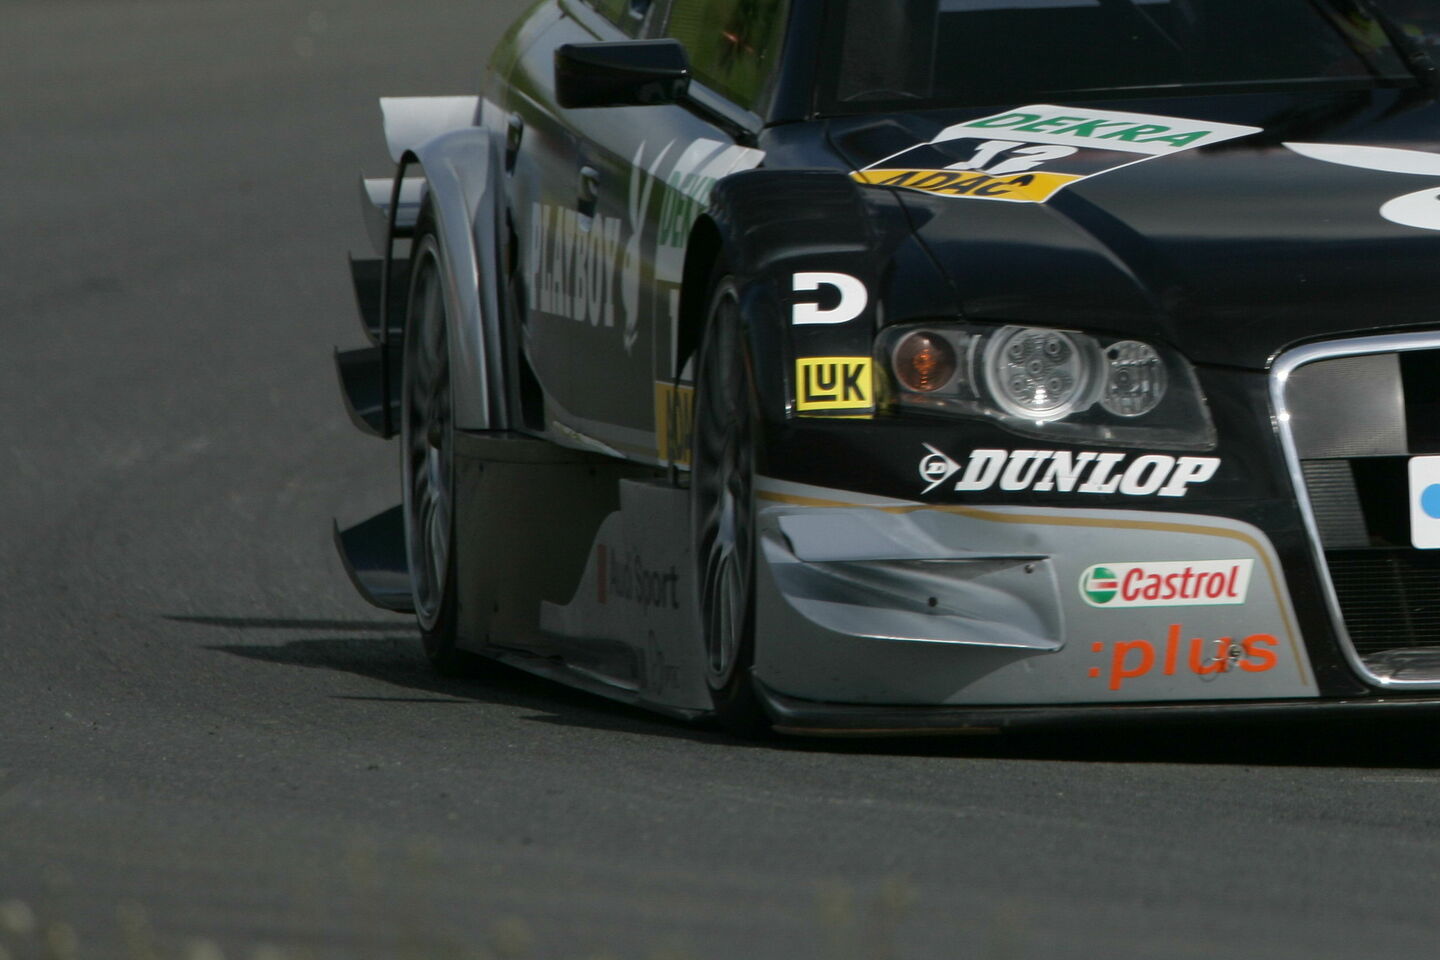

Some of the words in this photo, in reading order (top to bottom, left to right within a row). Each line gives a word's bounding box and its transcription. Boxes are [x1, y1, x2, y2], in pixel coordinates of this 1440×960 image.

[963, 112, 1214, 148] DEKRA
[942, 139, 1079, 175] 12
[879, 171, 1034, 197] ADAC
[529, 201, 622, 328] PLAYBOY
[954, 448, 1221, 497] DUNLOP
[1121, 565, 1241, 602] Castrol
[1088, 623, 1281, 691] :plus
